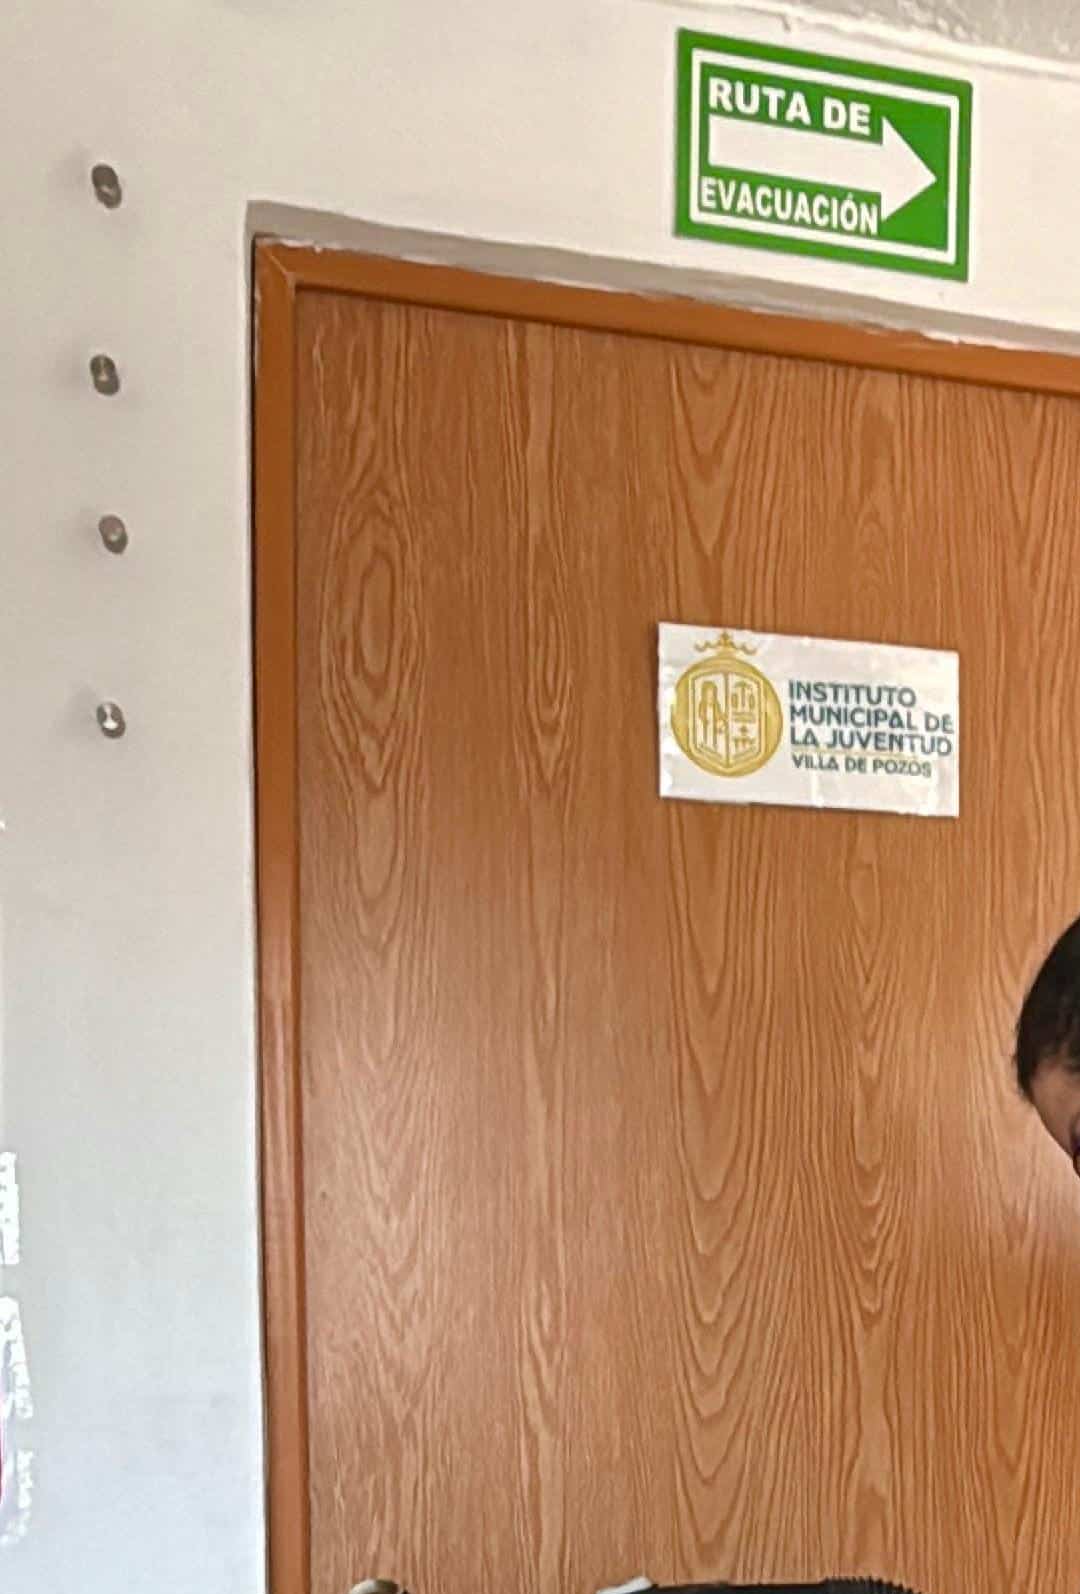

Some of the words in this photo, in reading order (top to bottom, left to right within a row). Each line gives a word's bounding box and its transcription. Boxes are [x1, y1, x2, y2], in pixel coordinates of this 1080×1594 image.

[708, 77, 811, 126] RUTA
[823, 96, 871, 136] DE
[700, 176, 879, 235] EVACUACIÓN
[789, 680, 917, 708] INSTITUTO
[790, 704, 917, 731] MUNICIPAL
[924, 711, 954, 734] DE
[790, 726, 819, 747] LA
[827, 728, 953, 757] JUVENTUD
[792, 753, 839, 771] VILLA
[845, 756, 867, 774] DE
[873, 758, 932, 778] POZOS
